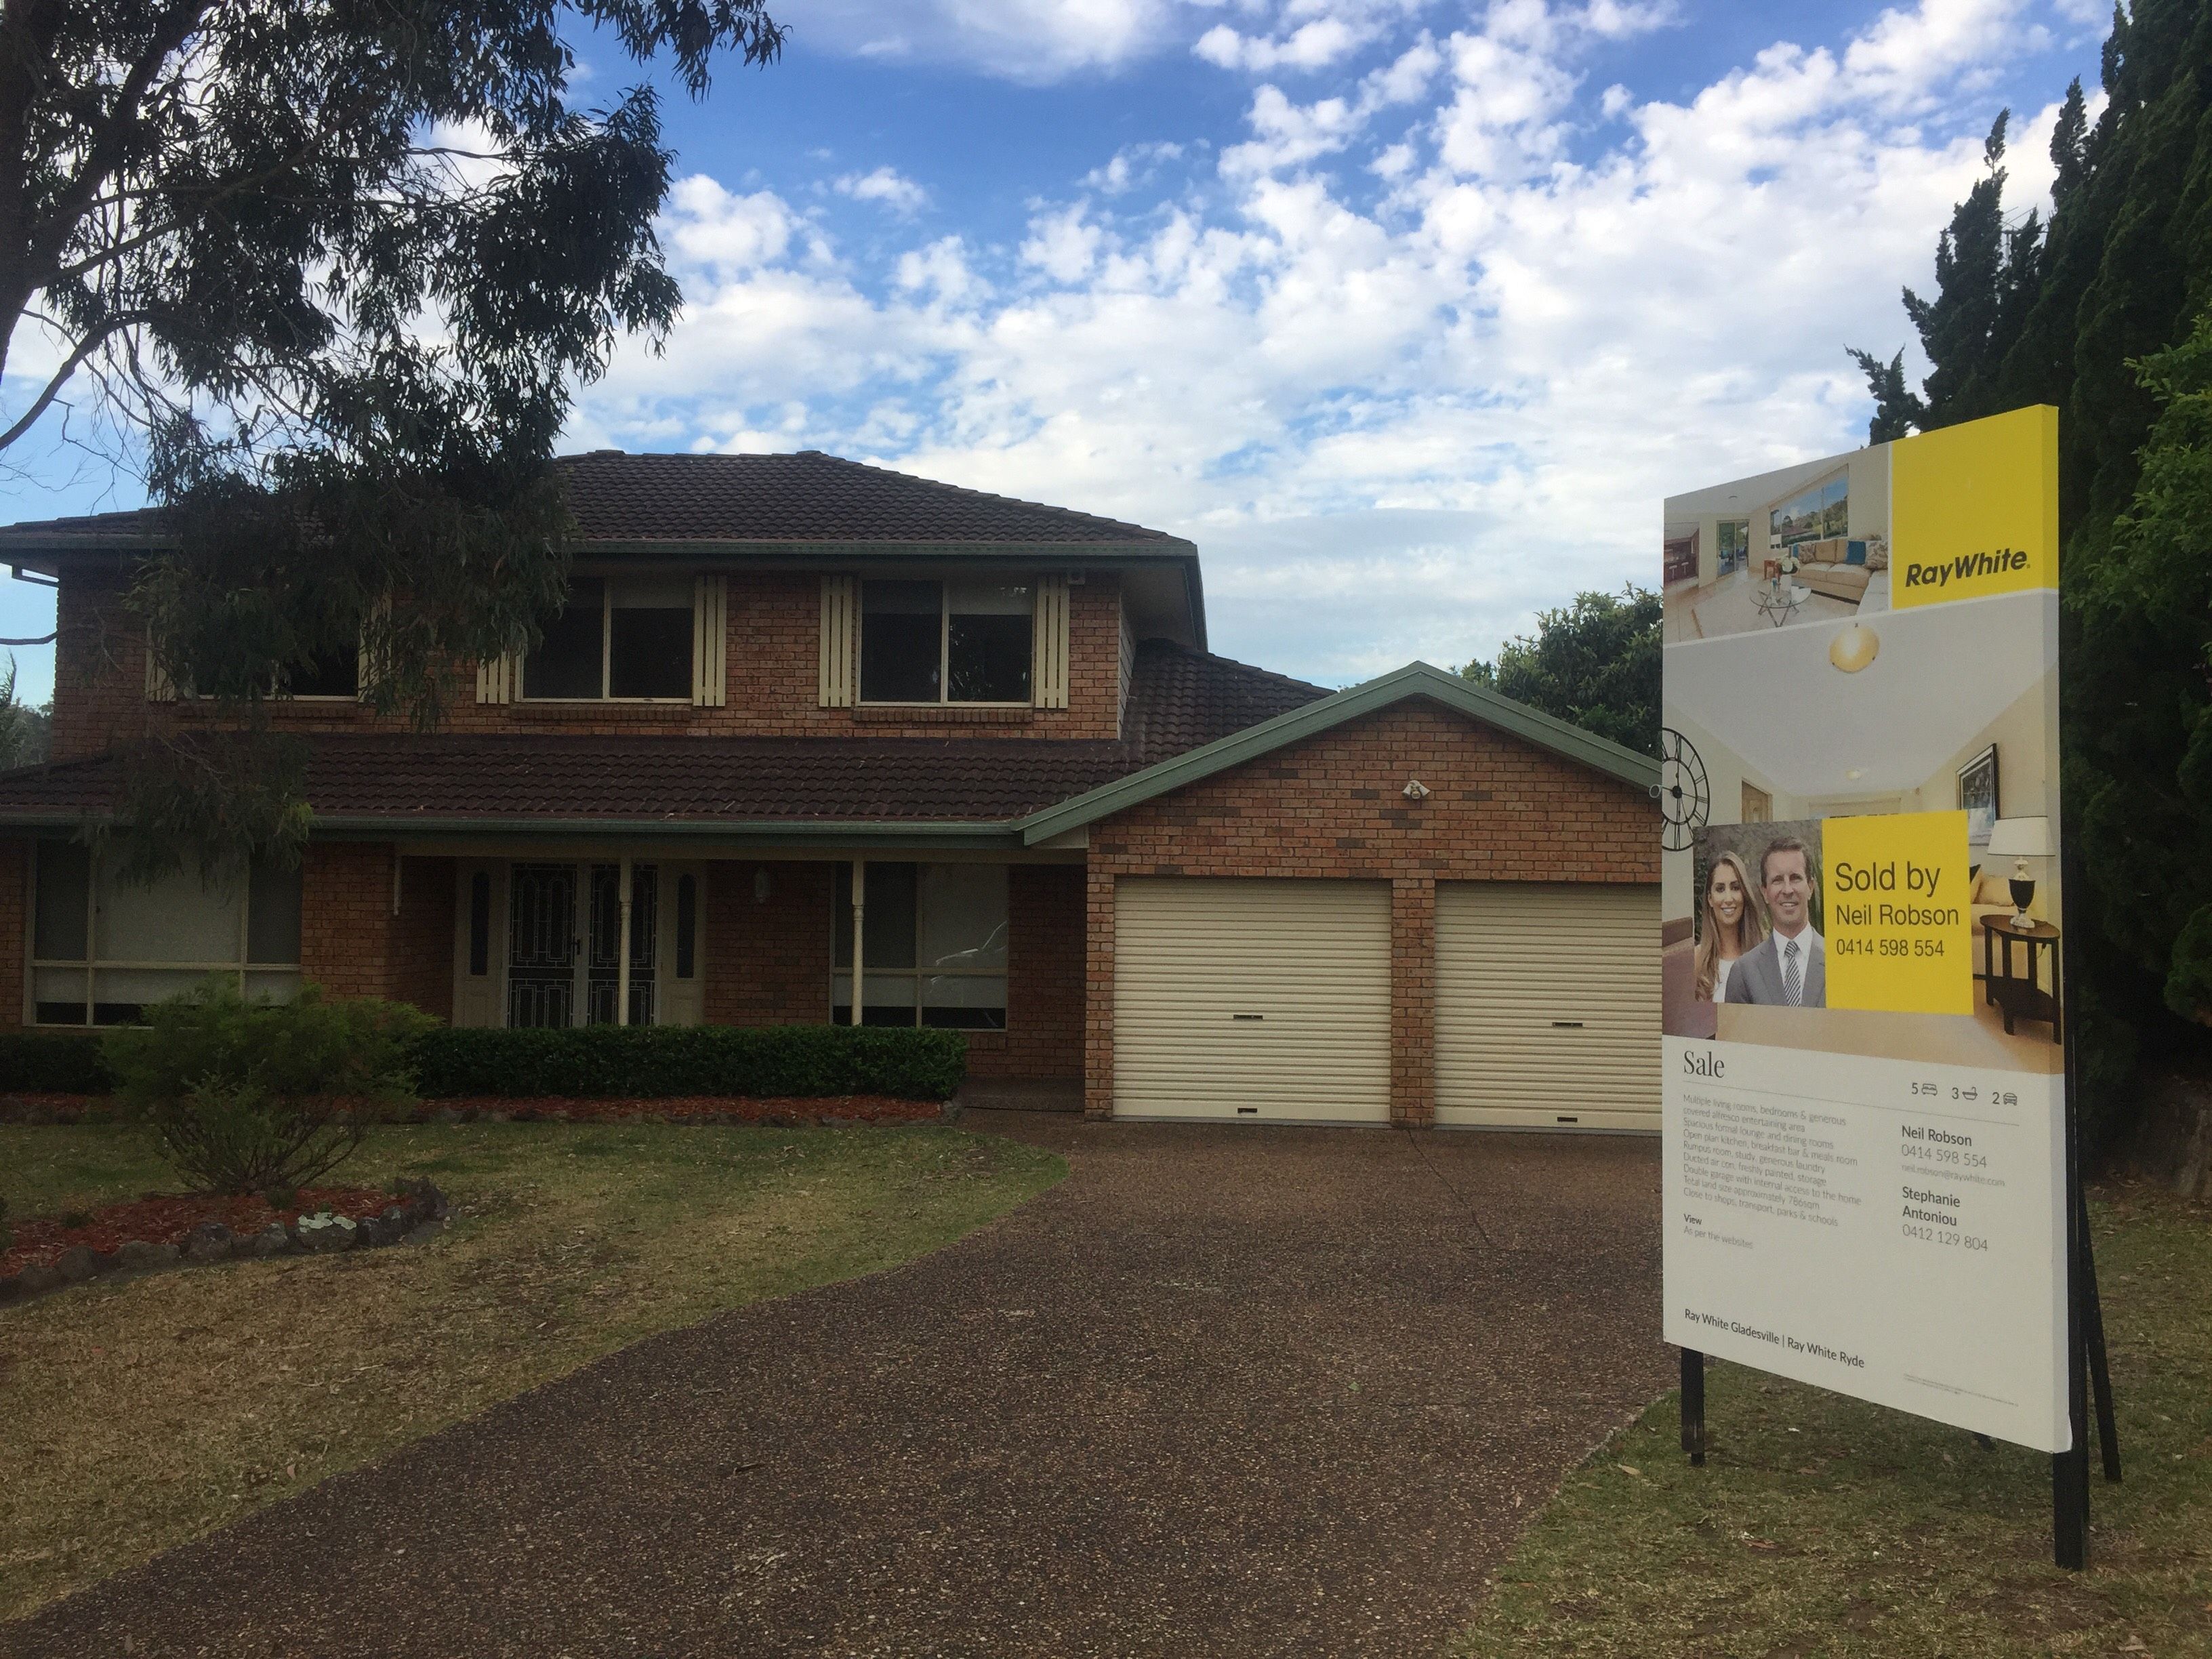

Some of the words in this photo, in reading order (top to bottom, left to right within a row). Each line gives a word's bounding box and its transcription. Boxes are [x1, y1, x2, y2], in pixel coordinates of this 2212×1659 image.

[1835, 861, 1896, 892] Sold
[1907, 861, 1941, 898] by
[1837, 904, 1872, 926] Neil
[1879, 903, 1959, 926] Robson
[1837, 939, 1874, 956] 0414
[1879, 939, 1908, 957] 598
[1914, 939, 1944, 957] 554
[1683, 1050, 1725, 1078] Sale
[1911, 1082, 1919, 1095] 5
[1952, 1087, 1959, 1100] 3
[1992, 1092, 2000, 1105] 2
[1683, 1094, 1711, 1106] Multiple
[1713, 1099, 1732, 1111] living
[1760, 1105, 1798, 1119] bedrooms
[1801, 1110, 1807, 1120] &
[1809, 1113, 1846, 1126] generous
[1683, 1107, 1711, 1118] covered
[1712, 1111, 1740, 1122] alfresco
[1742, 1115, 1786, 1132] entertaining
[1788, 1124, 1805, 1132] area
[1683, 1117, 1713, 1130] Spacious
[1715, 1122, 1738, 1134] formal
[1740, 1126, 1765, 1139] lounge
[1767, 1132, 1781, 1141] and
[1783, 1134, 1807, 1147] dining
[1809, 1139, 1834, 1150] rooms
[1683, 1128, 1702, 1139] Open
[1704, 1133, 1719, 1143] plan
[1721, 1135, 1749, 1149] kitchen,
[1751, 1140, 1785, 1154] breakfast
[1788, 1146, 1800, 1156] bar
[1803, 1148, 1809, 1158] &
[1811, 1151, 1833, 1163] meals
[1837, 1155, 1858, 1166] room
[1902, 1125, 1924, 1140] Neil
[1928, 1128, 1972, 1147] Robson
[1683, 1141, 1711, 1153] Rumpus
[1759, 1155, 1794, 1168] generous
[1796, 1160, 1825, 1174] laundry
[1683, 1152, 1708, 1165] Ducted
[1738, 1162, 1762, 1176] freshly
[1797, 1174, 1826, 1187] storage
[1902, 1144, 1931, 1160] 0414
[1936, 1149, 1959, 1164] 598
[1963, 1153, 1988, 1168] 554
[1683, 1164, 1708, 1176] Double
[1711, 1172, 1734, 1183] garage
[1736, 1176, 1752, 1185] with
[1754, 1178, 1782, 1190] internal
[1784, 1185, 1810, 1195] access
[1812, 1188, 1820, 1197] to
[1822, 1190, 1837, 1201] the
[1838, 1192, 1862, 1206] home
[1684, 1175, 1700, 1186] Total
[1702, 1180, 1717, 1189] land
[1719, 1183, 1732, 1193] size
[1734, 1187, 1785, 1205] approximately
[1902, 1186, 1961, 1208] Stephanie
[1683, 1187, 1703, 1199] Close
[1705, 1192, 1713, 1201] to
[1777, 1208, 1798, 1218] parks
[1800, 1210, 1805, 1220] &
[1808, 1214, 1838, 1227] schools
[1683, 1213, 1702, 1225] View
[1902, 1206, 1957, 1226] Antoniou
[1684, 1225, 1693, 1235] As
[1695, 1230, 1706, 1238] per
[1708, 1231, 1720, 1242] the
[1721, 1236, 1753, 1249] websites
[1902, 1224, 1933, 1242] 0412
[1938, 1231, 1960, 1246] 129
[1964, 1235, 1988, 1252] 804
[1685, 1309, 1700, 1323] Ray
[1702, 1313, 1729, 1330] White
[1731, 1322, 1780, 1345] Gladesville
[1787, 1337, 1805, 1353] Ray
[1807, 1342, 1837, 1361] White
[1839, 1351, 1865, 1368] Ryde
